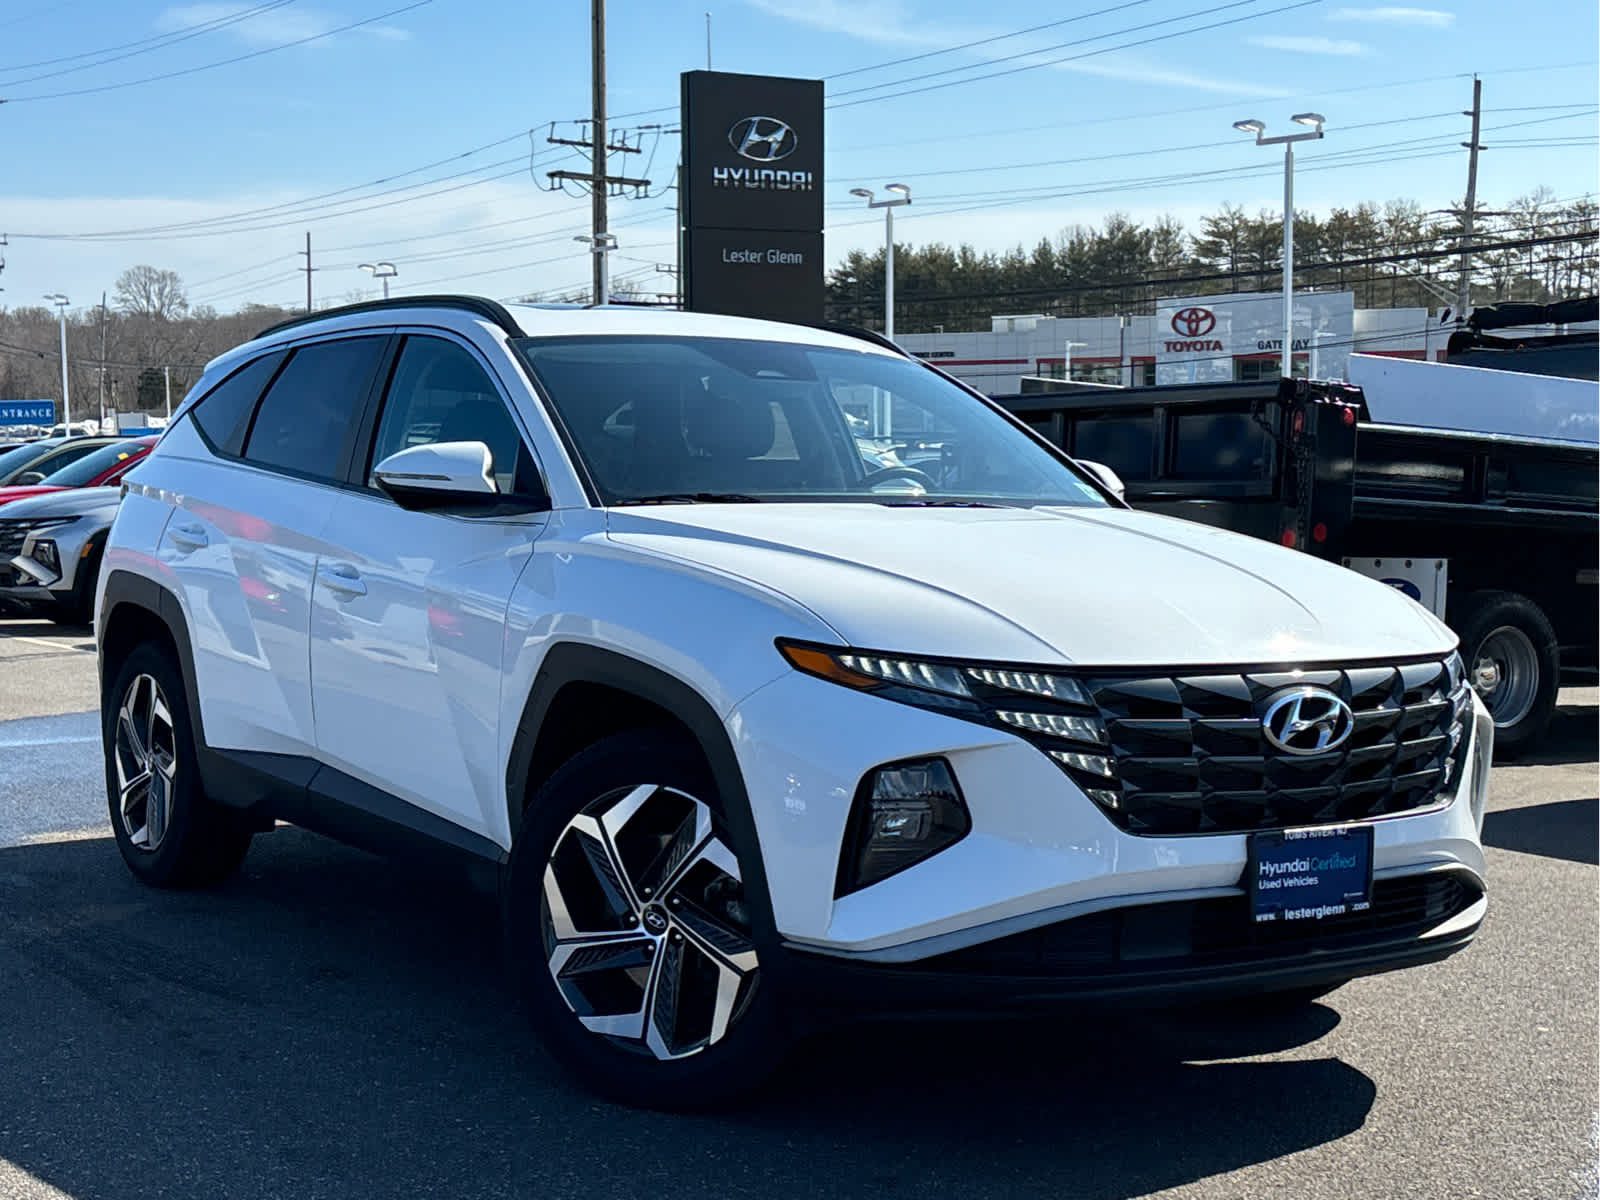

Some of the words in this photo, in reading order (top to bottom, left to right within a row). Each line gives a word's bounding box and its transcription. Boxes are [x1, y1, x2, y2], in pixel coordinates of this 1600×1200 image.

[713, 167, 813, 190] HYUNDAI
[722, 248, 763, 264] Lester
[767, 249, 802, 264] Glenn
[1164, 340, 1223, 352] TOYOTA
[0, 408, 52, 417] NTRANCE
[1259, 858, 1310, 877] Hyundai
[1311, 853, 1356, 871] Certified
[1259, 879, 1281, 890] Used
[1283, 876, 1319, 887] Vehicles
[1285, 904, 1345, 920] lesterglenn
